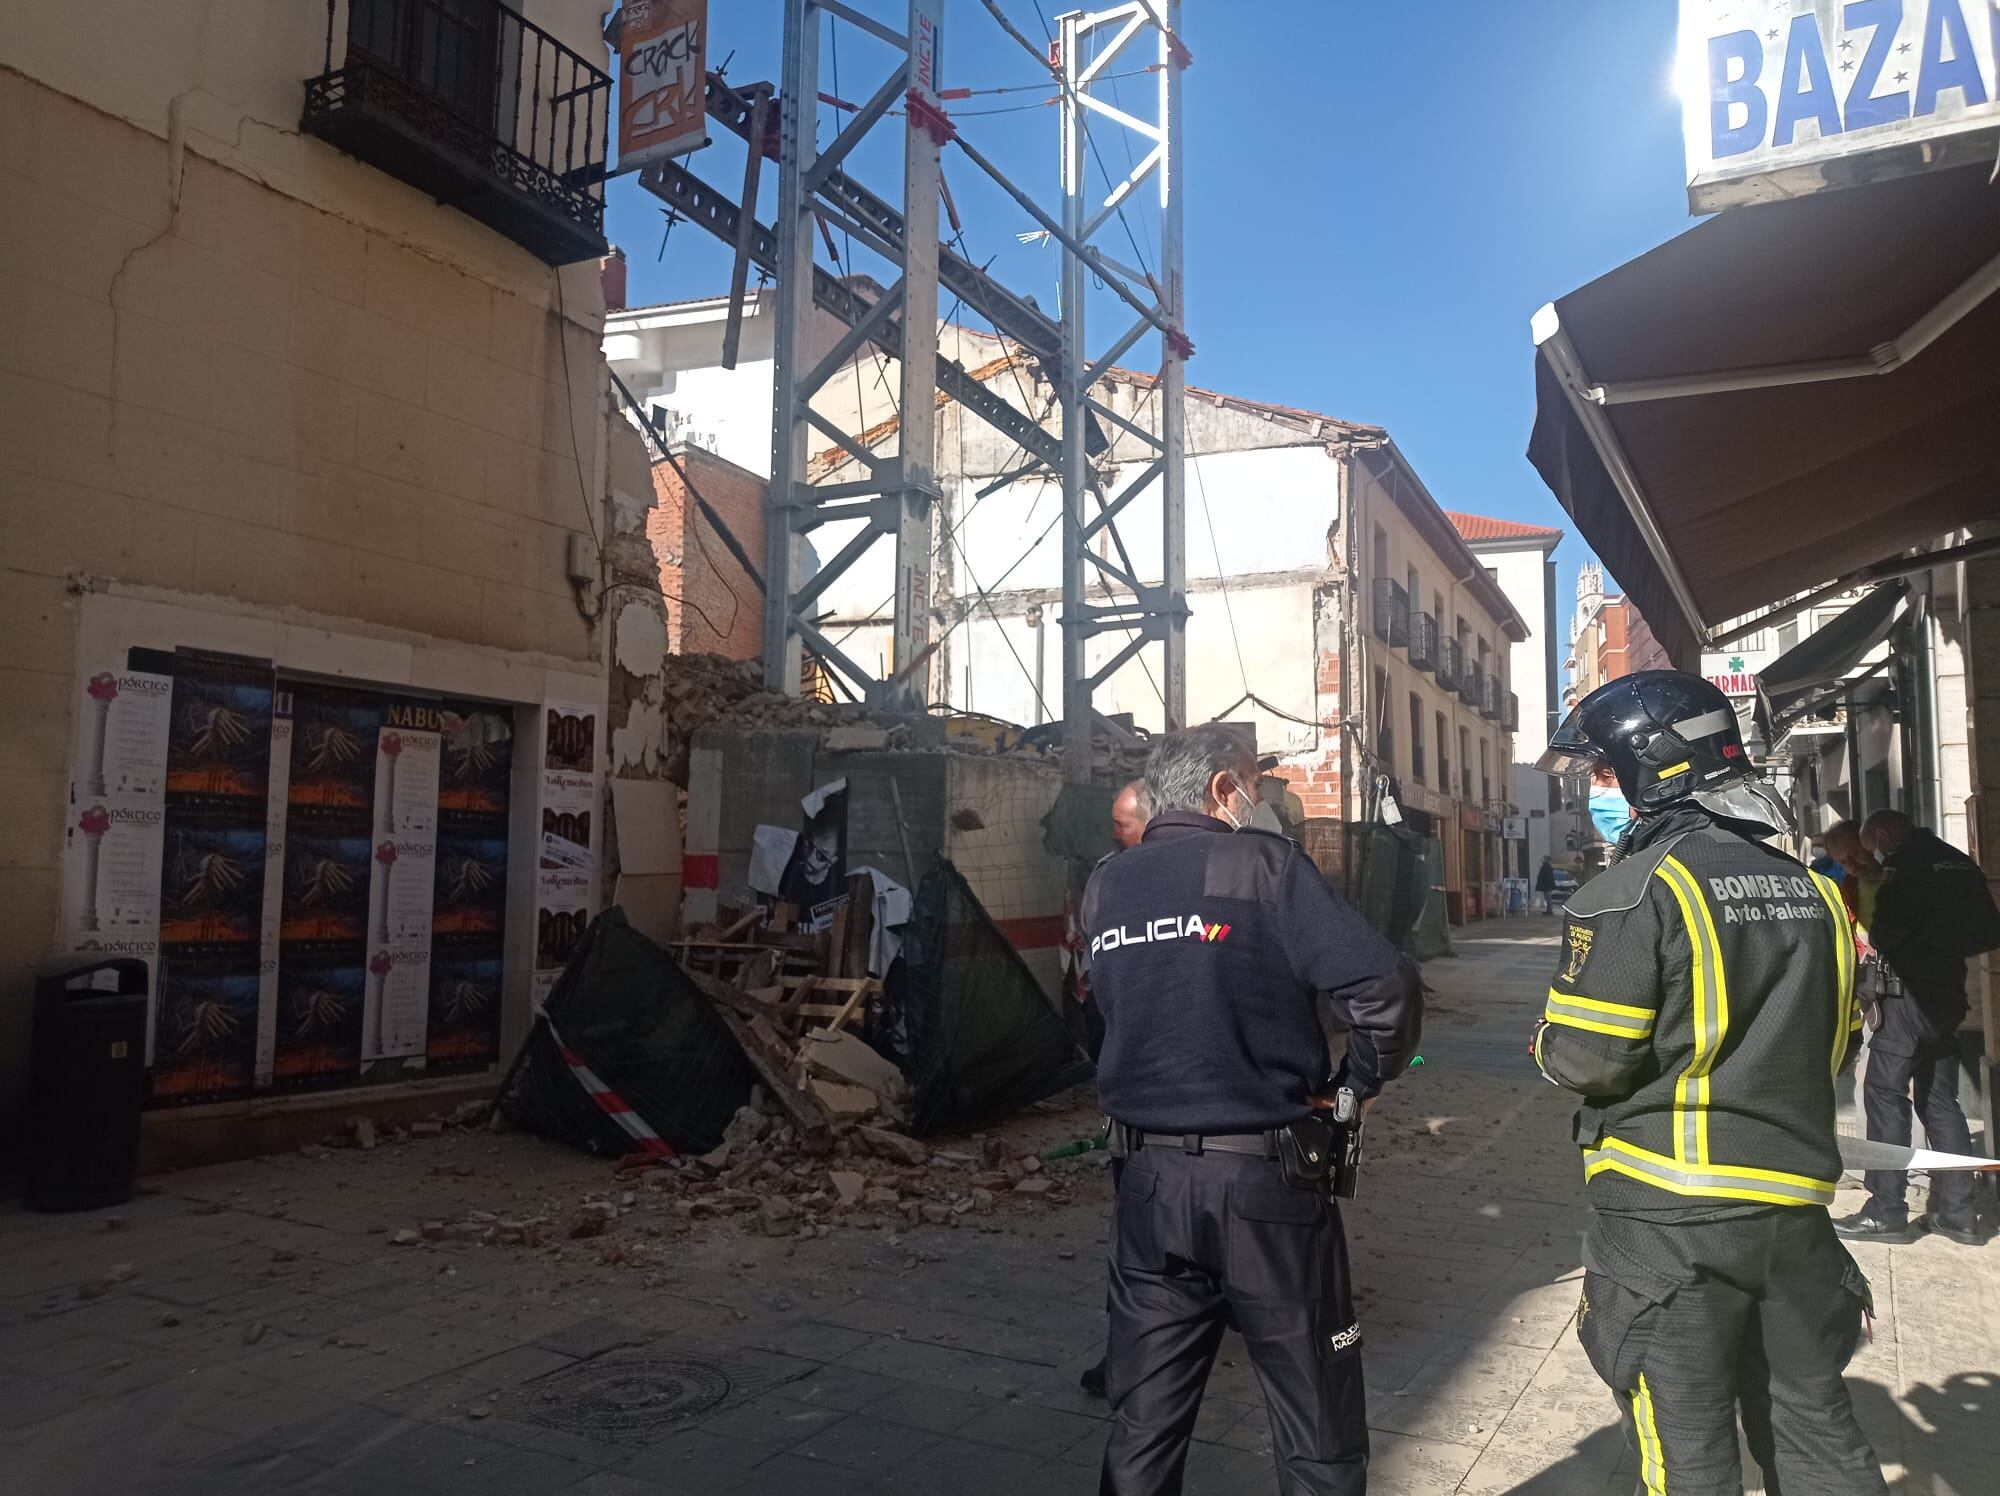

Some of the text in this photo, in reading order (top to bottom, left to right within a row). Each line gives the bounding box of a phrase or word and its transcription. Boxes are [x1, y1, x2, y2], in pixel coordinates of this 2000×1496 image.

[625, 20, 701, 78] CRACK
[1707, 0, 2000, 160] BAZA
[1708, 874, 1820, 901] BOMBEROS
[1091, 914, 1207, 962] POLICIA
